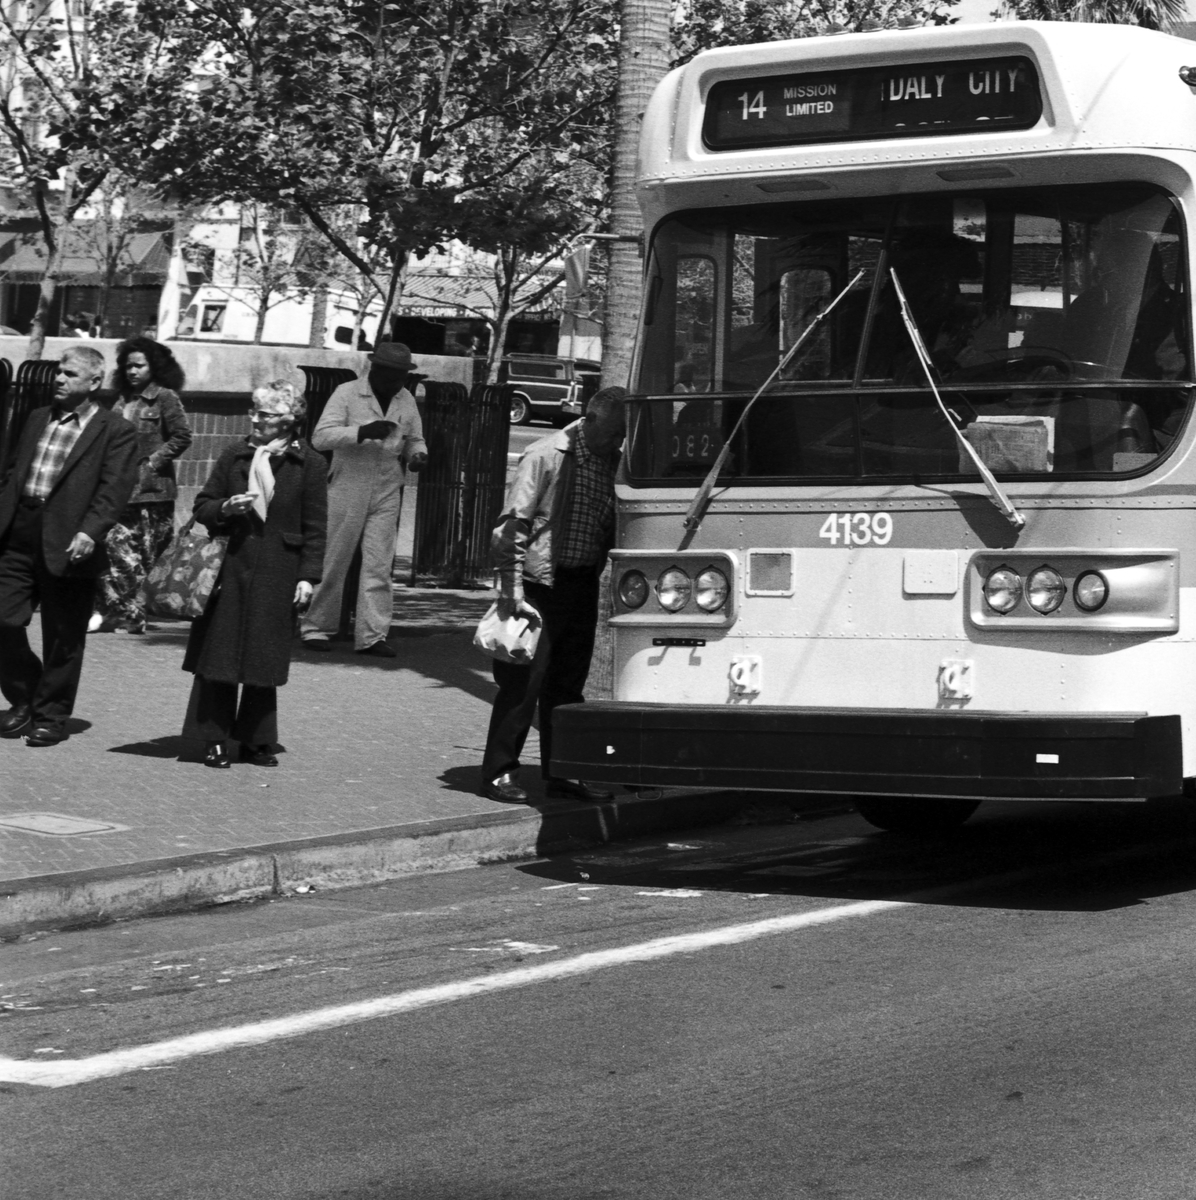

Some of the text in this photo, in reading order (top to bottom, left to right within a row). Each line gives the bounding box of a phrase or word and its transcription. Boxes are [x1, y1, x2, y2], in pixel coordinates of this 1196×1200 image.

[889, 69, 1019, 101] DALY CITY
[737, 83, 837, 120] 14 MISSION
[785, 100, 834, 116] LIMITED
[410, 306, 458, 317] DEVELOPING
[819, 513, 893, 545] 4139
